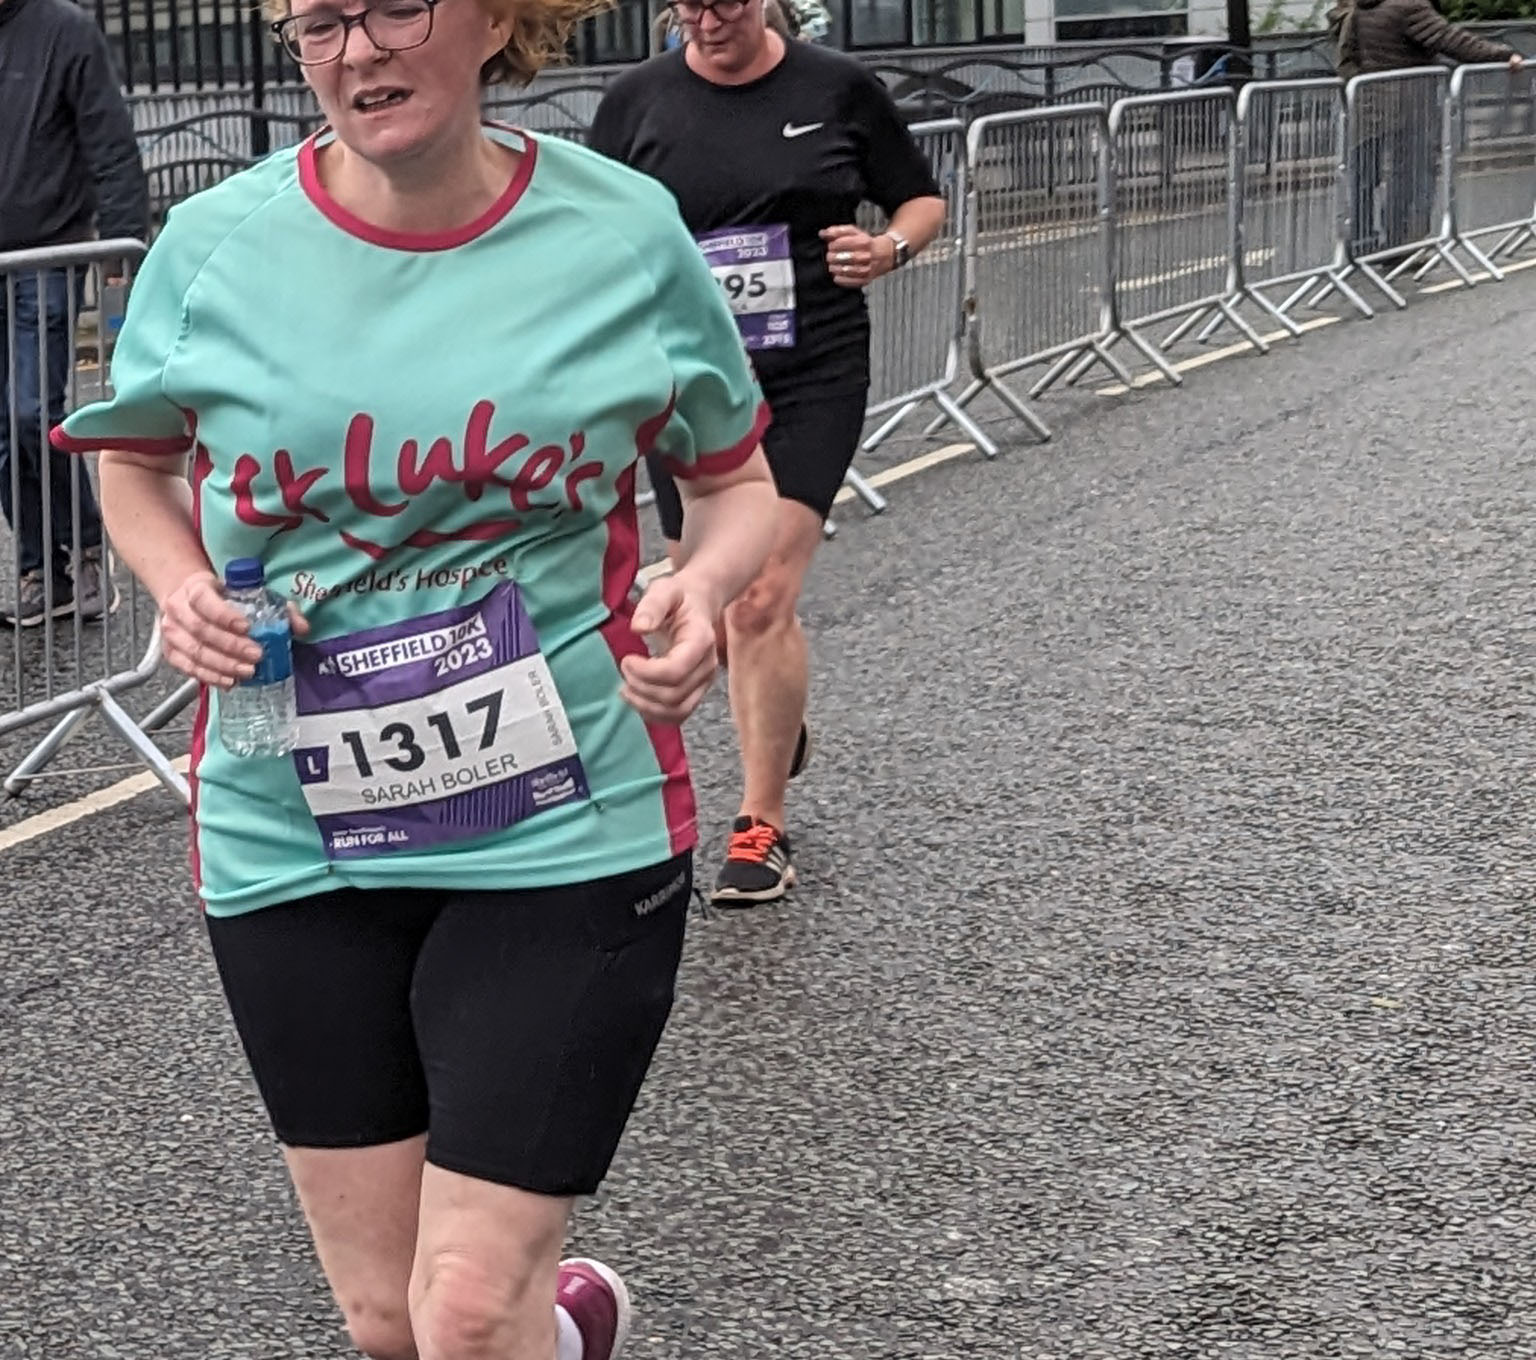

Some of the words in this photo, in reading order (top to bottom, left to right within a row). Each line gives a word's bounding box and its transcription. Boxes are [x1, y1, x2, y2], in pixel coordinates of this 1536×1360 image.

[714, 271, 767, 300] 95
[344, 399, 604, 517] Luke's
[414, 555, 508, 595] Hospce
[339, 634, 447, 675] SHEFFIELD
[448, 617, 484, 648] 10K
[434, 638, 494, 677] 2023
[341, 688, 506, 778] 1317
[306, 755, 322, 776] L
[361, 778, 437, 805] SARAH
[442, 753, 519, 791] BOLER
[334, 834, 360, 850] RUN
[361, 832, 386, 848] FOR
[387, 829, 409, 843] ALL
